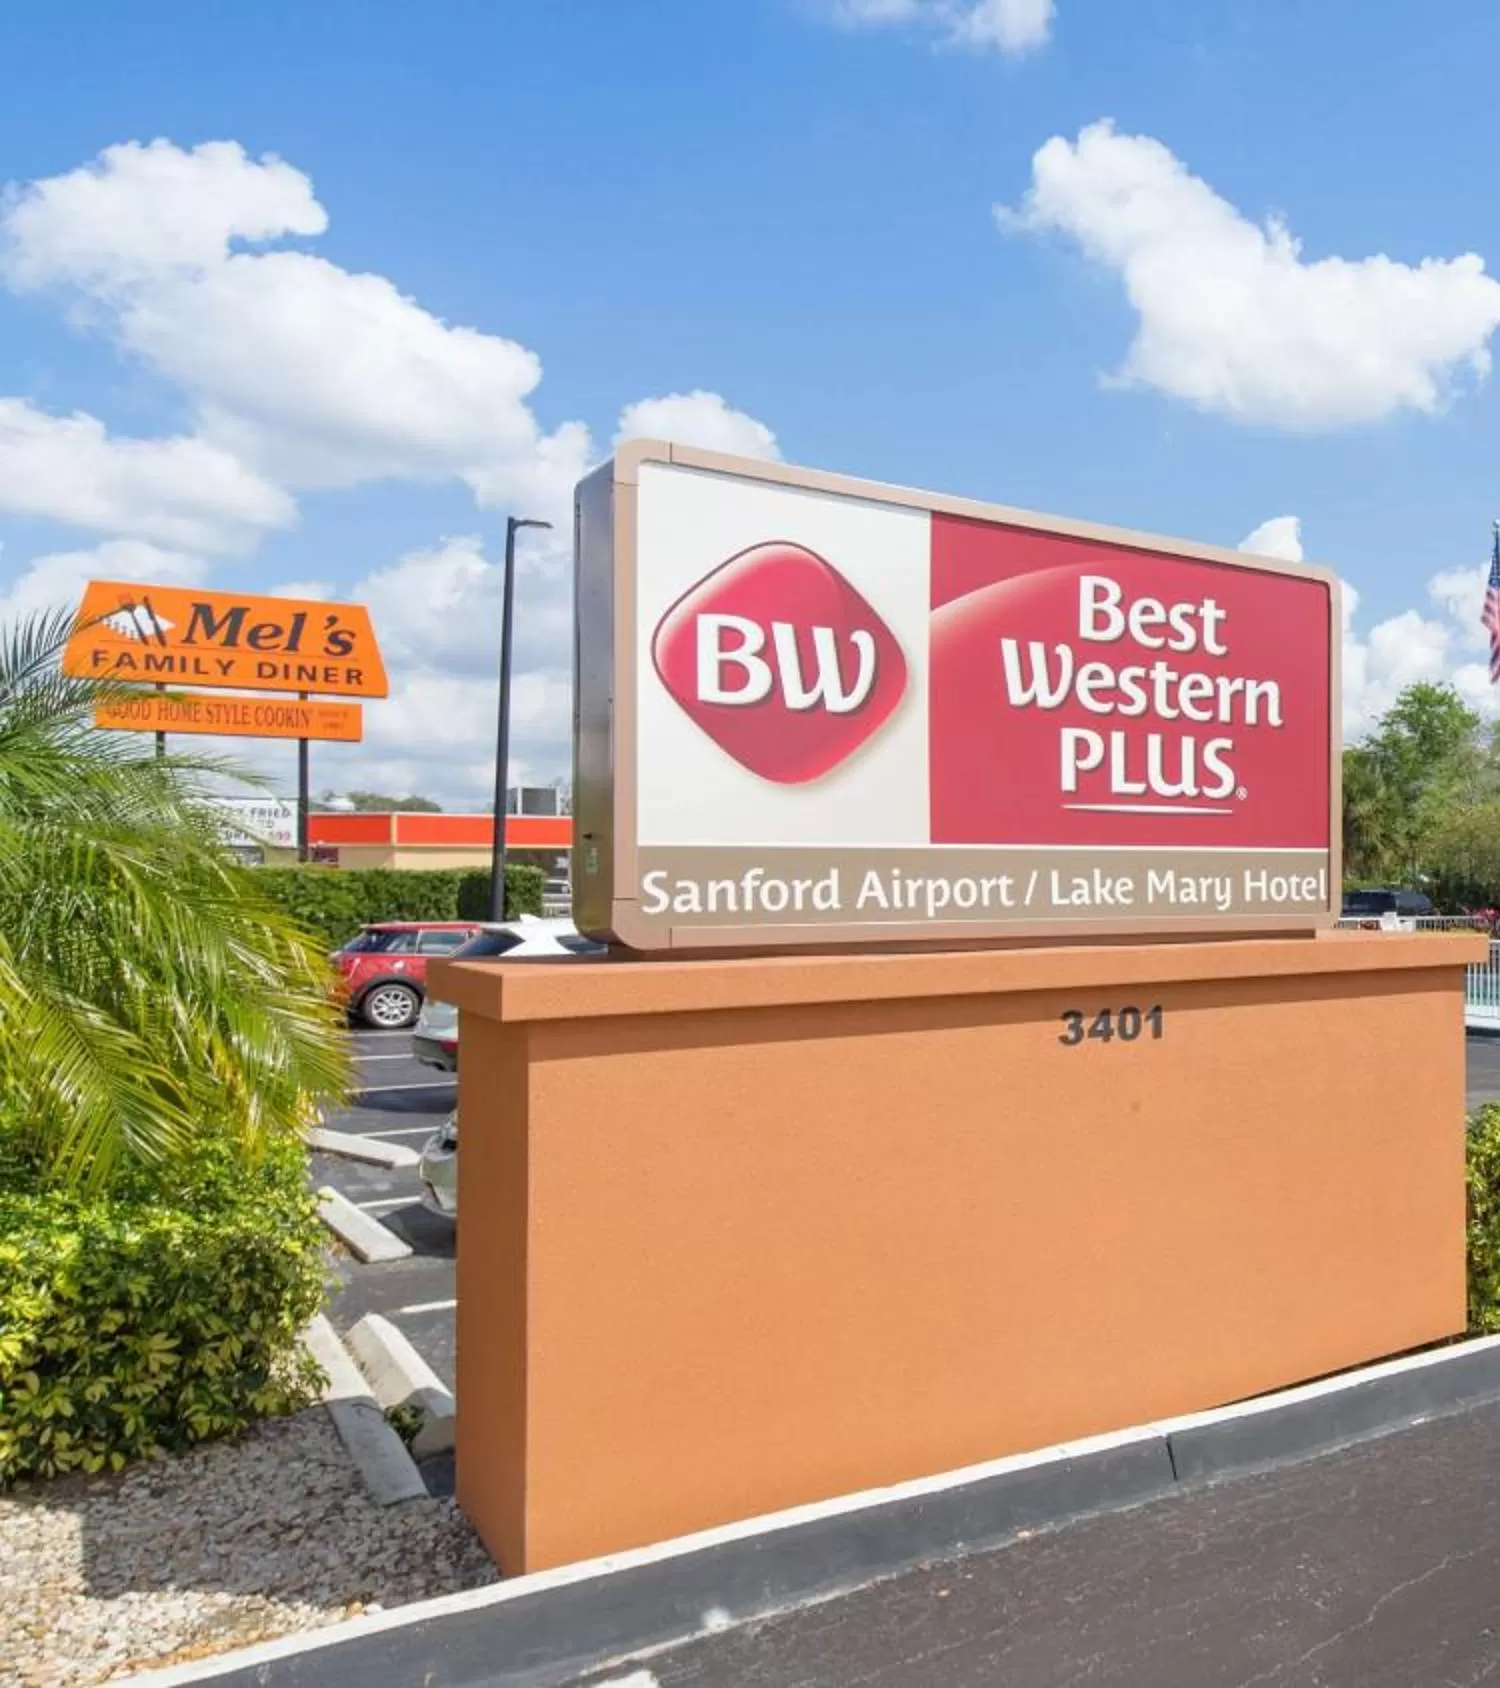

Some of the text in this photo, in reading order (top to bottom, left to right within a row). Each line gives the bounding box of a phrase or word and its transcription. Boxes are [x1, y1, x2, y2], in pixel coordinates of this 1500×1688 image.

[181, 602, 357, 657] Mel's
[1078, 575, 1227, 656] Best
[92, 648, 363, 686] FAMILY DINER
[697, 612, 876, 713] BW
[1001, 637, 1283, 728] Western
[157, 702, 201, 724] HOME
[205, 704, 251, 726] STYLE
[642, 867, 841, 913] Sanford
[856, 868, 1015, 917] Airport
[1050, 868, 1134, 906] Lake
[1147, 869, 1232, 911] Mary
[1244, 868, 1328, 902] Hotel
[1058, 1004, 1163, 1046] 3401
